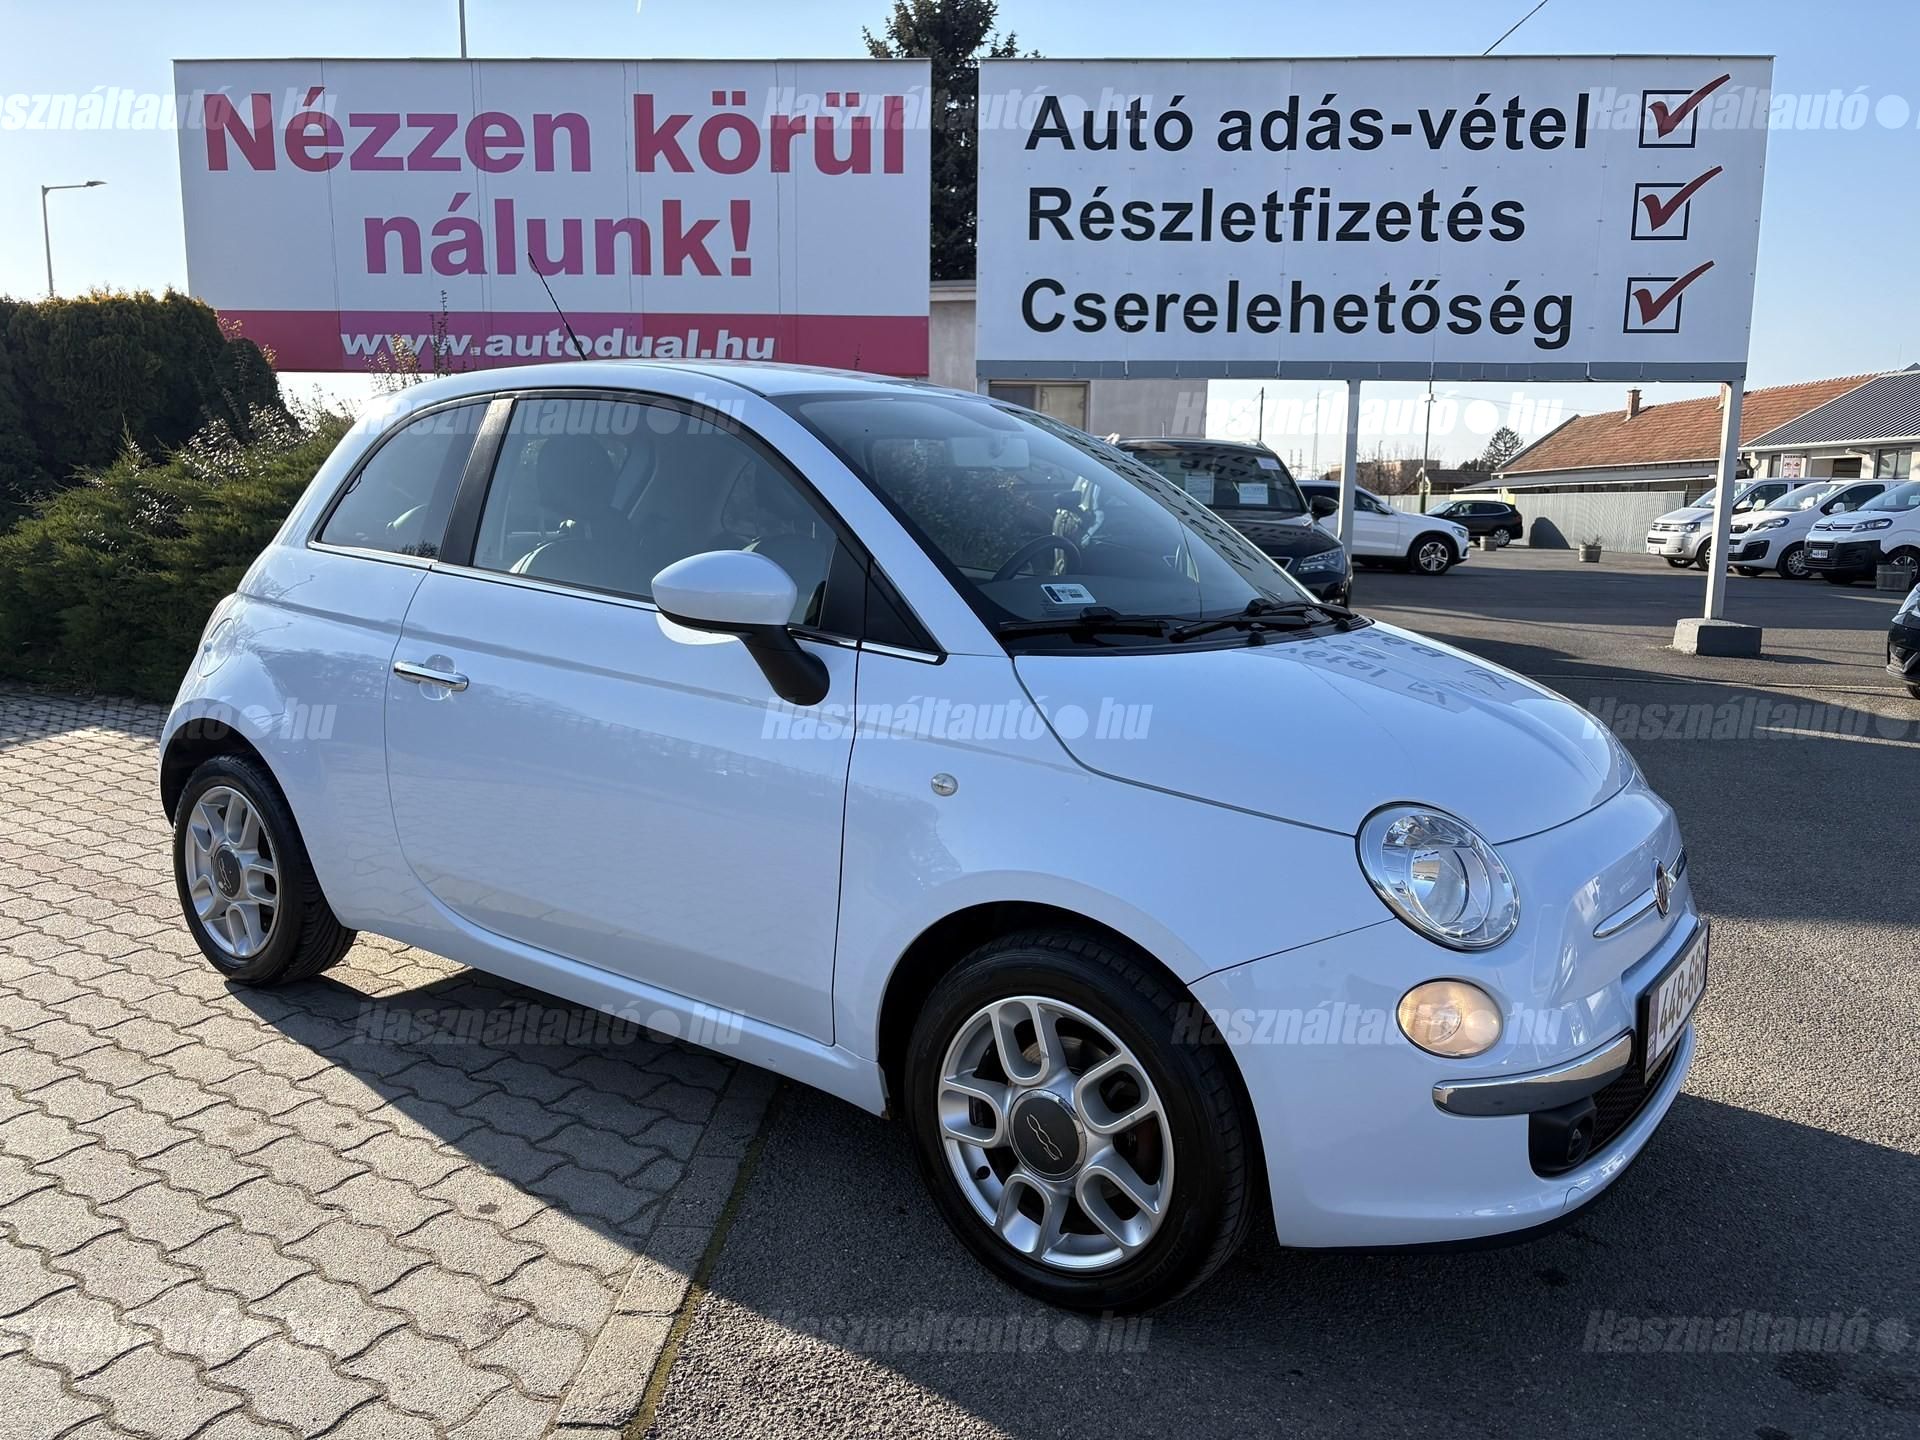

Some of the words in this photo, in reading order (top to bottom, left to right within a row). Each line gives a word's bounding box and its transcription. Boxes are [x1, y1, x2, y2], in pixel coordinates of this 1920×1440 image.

[205, 86, 591, 172] Nézzen
[635, 91, 904, 174] körül
[1024, 94, 1194, 152] Autó
[1217, 92, 1590, 152] adás-vétel
[365, 192, 751, 276] nálunk!
[1028, 186, 1526, 243] Részletfizetés
[340, 326, 776, 361] www.autodual.hu
[1021, 277, 1574, 350] Cserelehetőség
